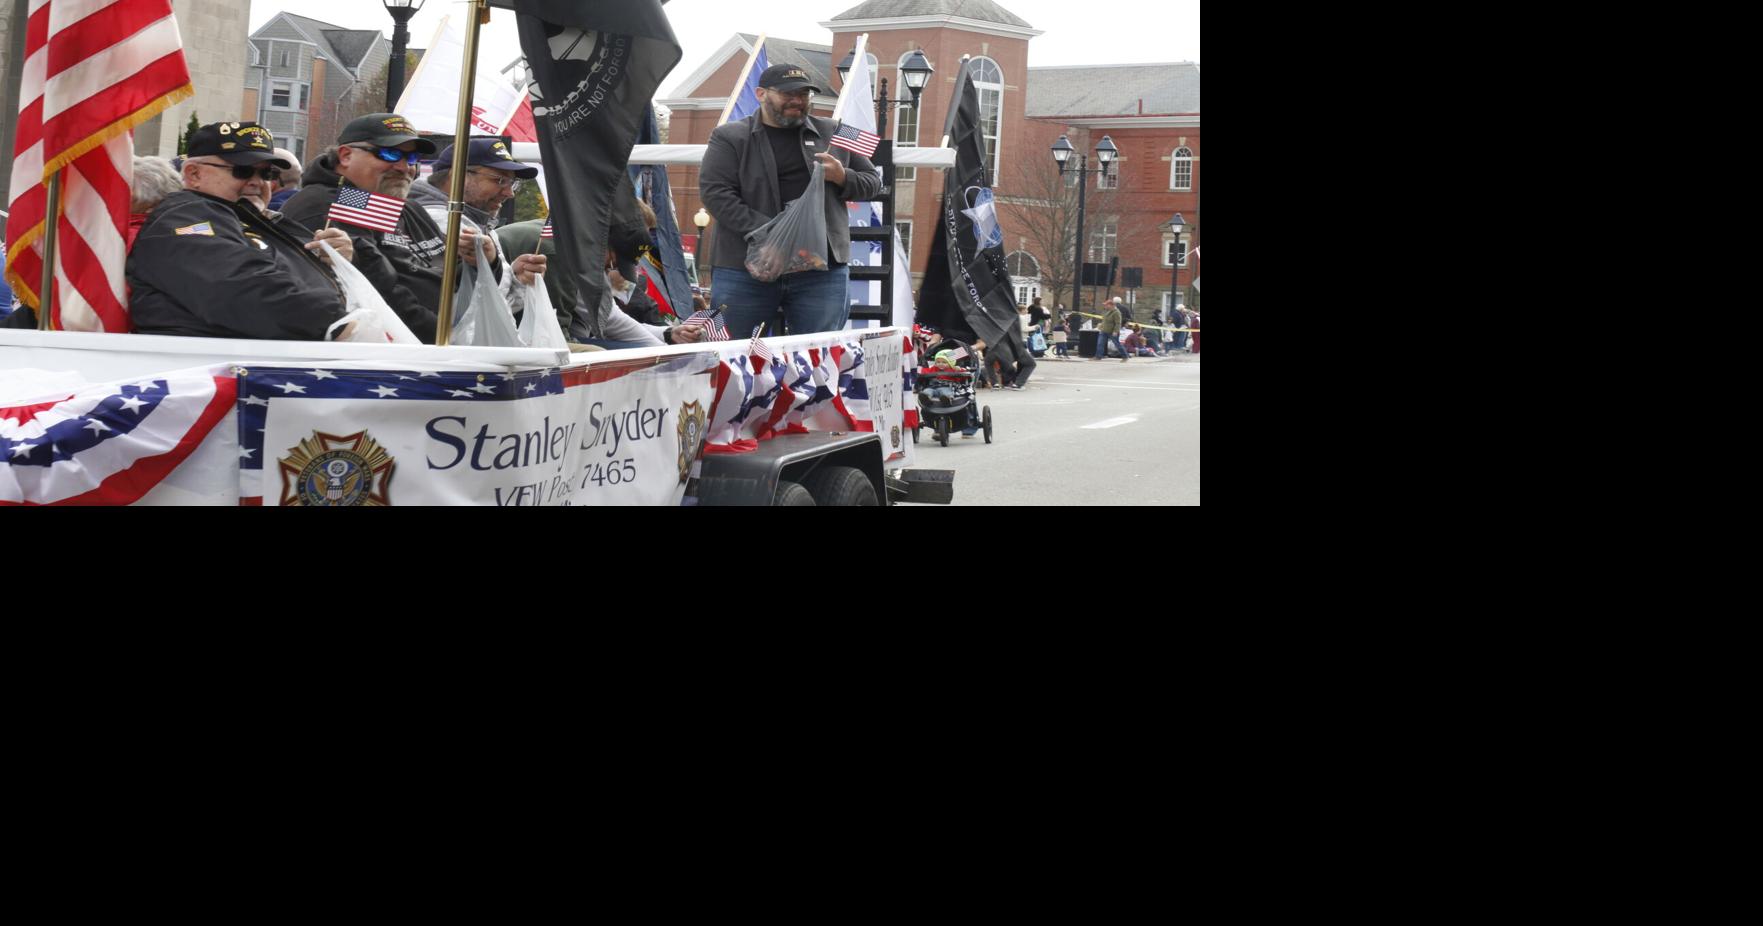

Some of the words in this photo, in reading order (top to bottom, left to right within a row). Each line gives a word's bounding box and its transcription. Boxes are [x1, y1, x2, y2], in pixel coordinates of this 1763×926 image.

[553, 119, 570, 134] YOU
[568, 105, 592, 126] ARE
[588, 83, 607, 108] NOT
[424, 415, 576, 472] Stanley
[579, 398, 669, 458] Snyder
[494, 480, 548, 506] VFW
[580, 458, 637, 490] 7465
